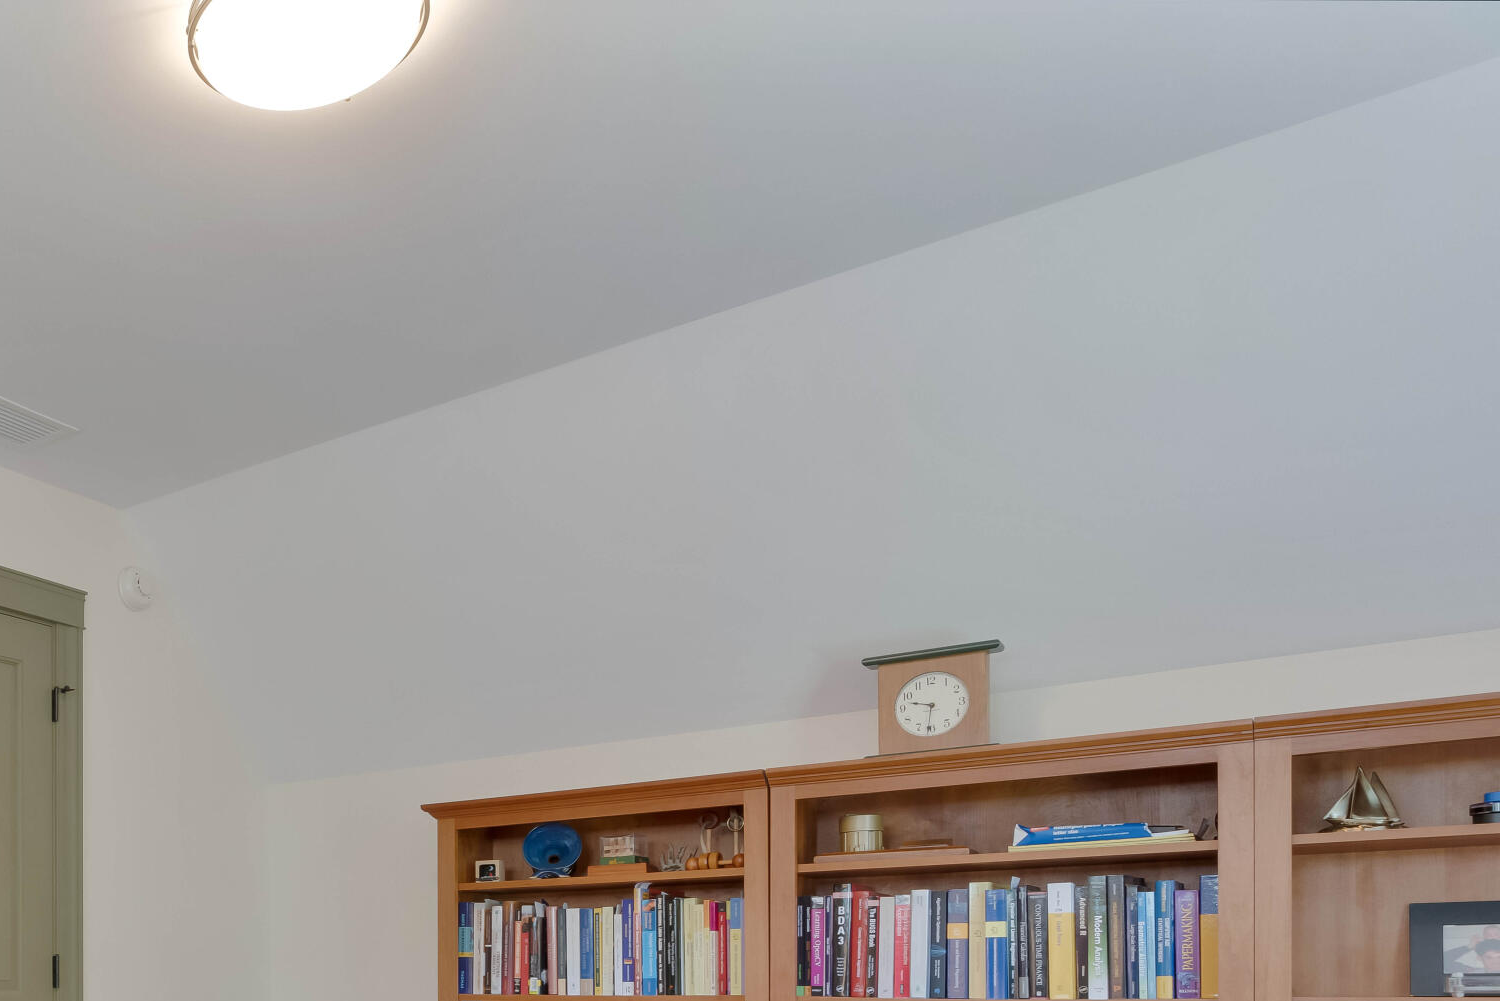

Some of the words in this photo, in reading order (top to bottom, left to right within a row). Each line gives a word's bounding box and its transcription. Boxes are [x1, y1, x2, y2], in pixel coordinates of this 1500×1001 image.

[926, 677, 936, 685] 12
[945, 678, 948, 686] 1
[915, 682, 921, 690] 11
[904, 692, 912, 701] 10
[959, 697, 965, 705] 3
[944, 719, 950, 727] 5
[813, 911, 824, 938] Learning
[1181, 903, 1193, 970] PAPERMAKING
[814, 940, 824, 967] OpenCV
